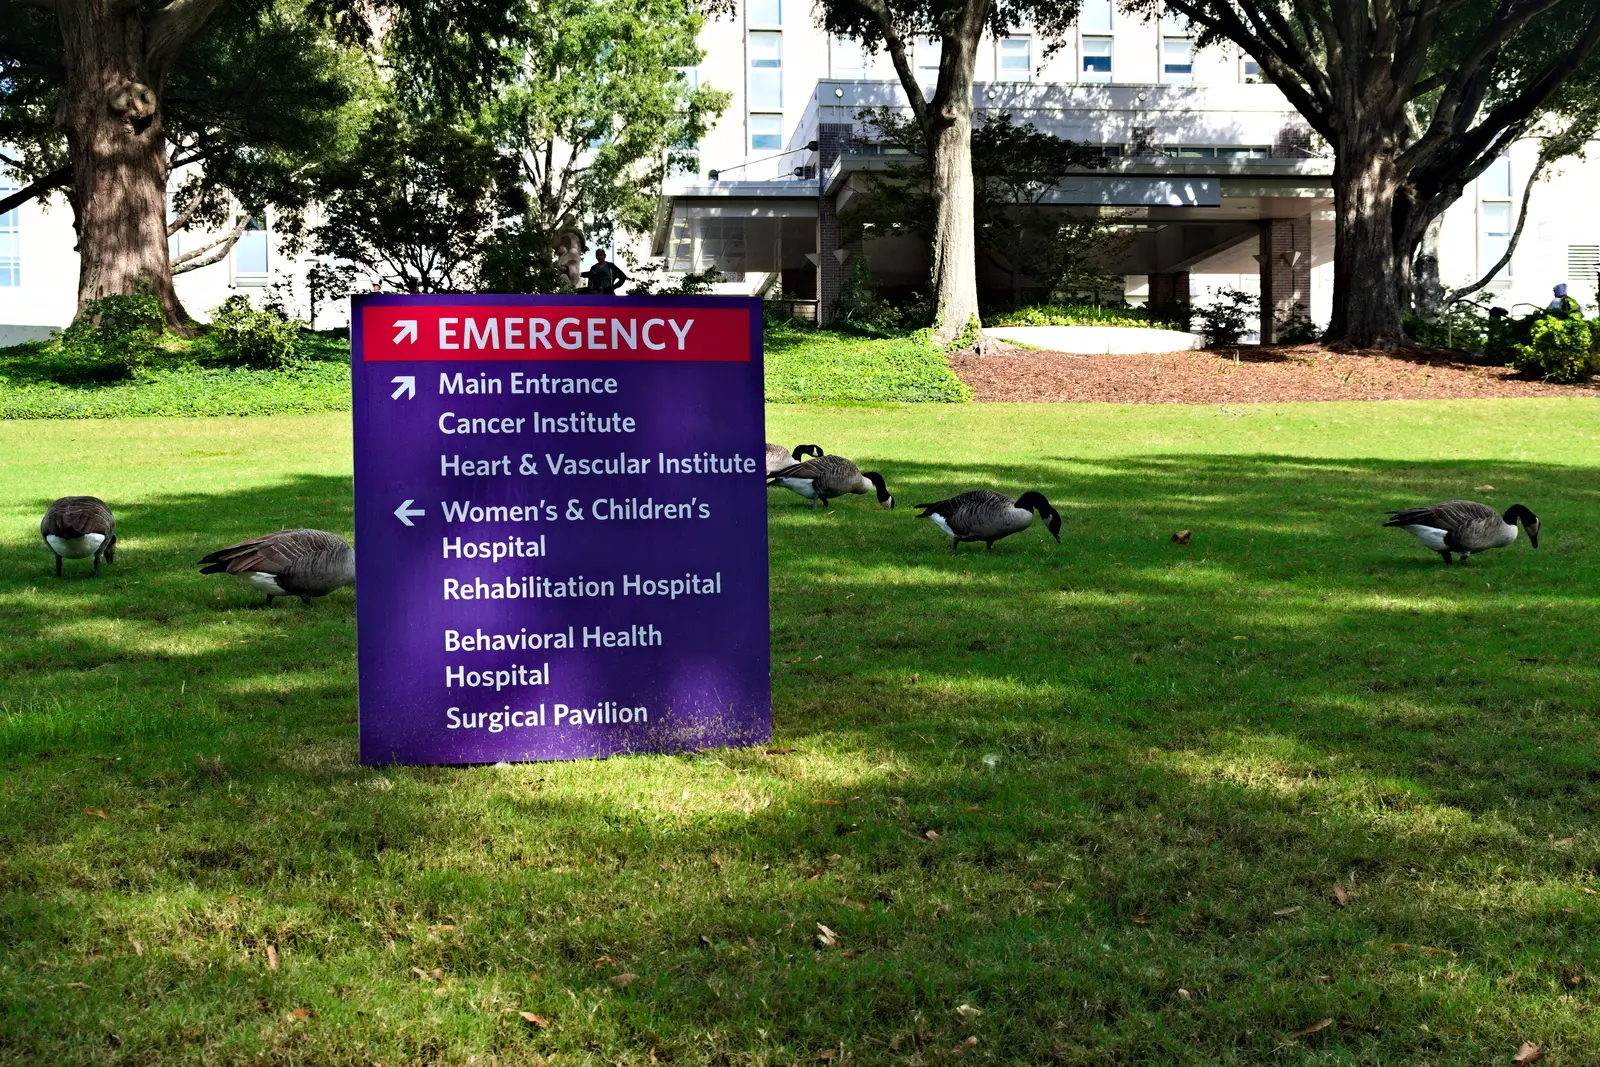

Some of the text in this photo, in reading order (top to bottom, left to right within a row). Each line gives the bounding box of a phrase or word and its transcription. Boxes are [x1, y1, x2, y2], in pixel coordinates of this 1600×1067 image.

[438, 317, 695, 351] EMERGENCY
[439, 372, 618, 395] Main Entrance
[438, 410, 636, 435] Cancer Institute
[440, 451, 756, 477] Heart & Vascular Institute
[440, 496, 711, 523] Women's & Children's
[442, 534, 546, 562] Hospital
[443, 571, 721, 601] Rehabilitation Hospital
[444, 623, 662, 652] Behavioral Health
[445, 662, 550, 692] Hospital
[446, 701, 648, 733] Surgical Pavilion
